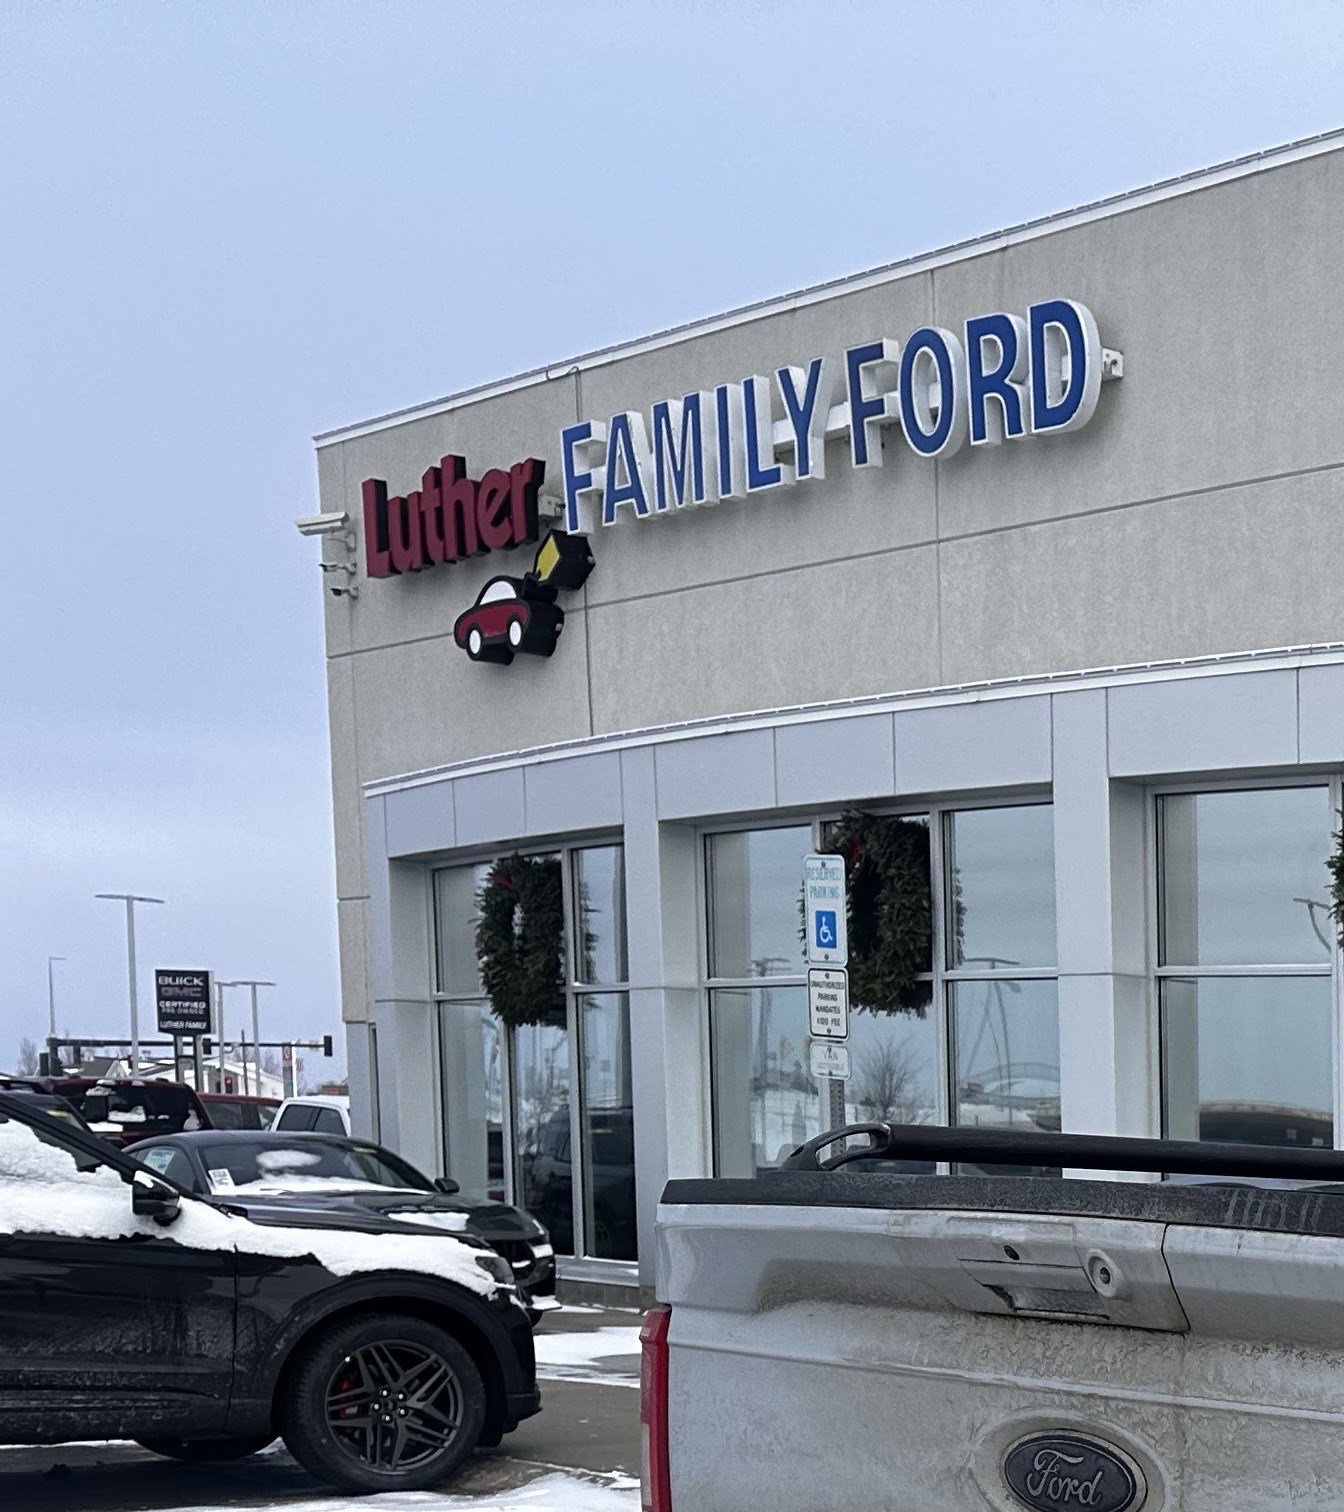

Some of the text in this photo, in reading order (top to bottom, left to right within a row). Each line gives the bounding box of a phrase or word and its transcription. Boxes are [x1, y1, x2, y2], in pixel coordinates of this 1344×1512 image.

[559, 298, 1101, 535] FAMILY FORD
[362, 454, 545, 578] Luther
[158, 975, 204, 986] BUICK
[1026, 1448, 1104, 1506] Ford
